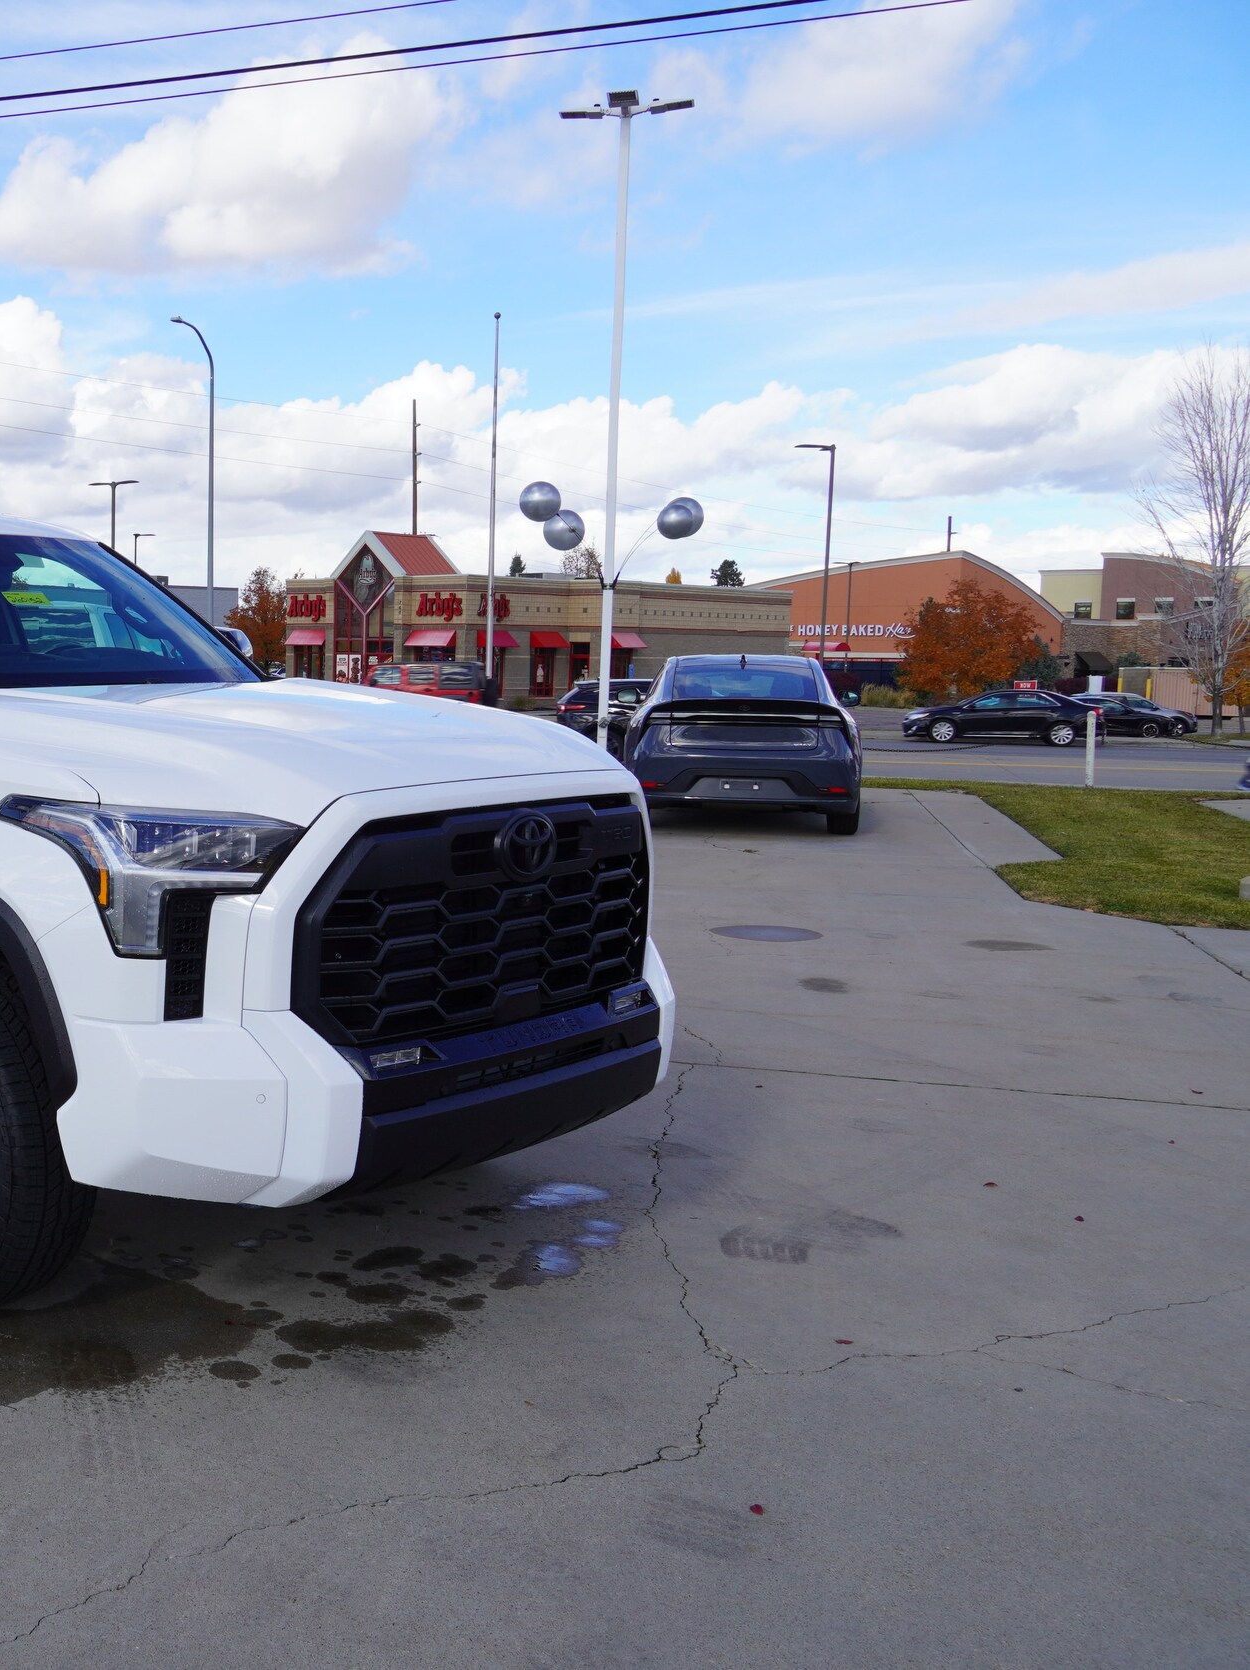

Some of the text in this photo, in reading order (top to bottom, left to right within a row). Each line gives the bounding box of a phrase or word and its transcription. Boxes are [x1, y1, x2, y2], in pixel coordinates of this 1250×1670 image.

[287, 593, 327, 622] Arby's
[416, 592, 463, 622] Arby's
[477, 592, 511, 622] Aby's
[798, 624, 839, 636] HONEY
[841, 624, 884, 636] BAKED
